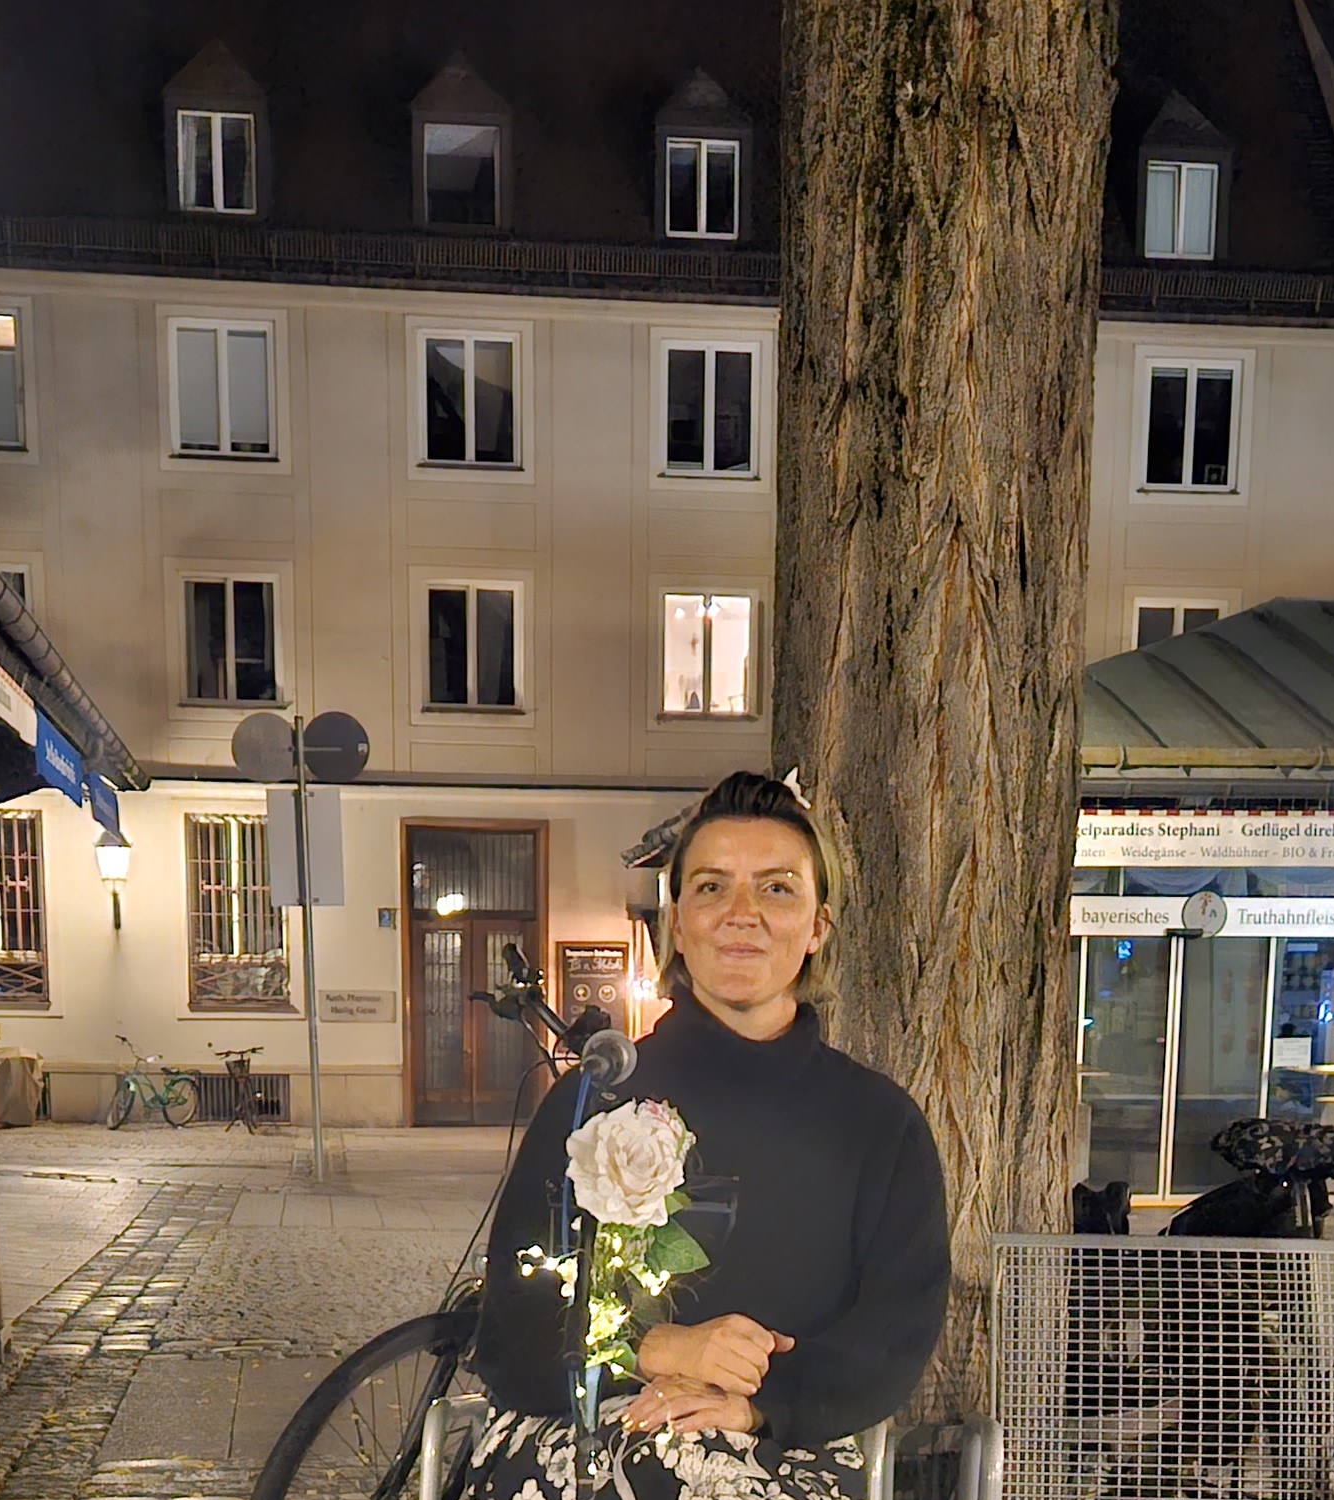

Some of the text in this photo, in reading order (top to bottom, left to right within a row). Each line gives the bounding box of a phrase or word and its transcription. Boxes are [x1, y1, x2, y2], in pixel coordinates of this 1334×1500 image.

[1158, 822, 1220, 840] Stephani
[1241, 822, 1300, 841] Geflügel
[1076, 847, 1106, 858] nten
[1121, 846, 1186, 861] Weidegänse
[1200, 846, 1268, 858] Waldhühner
[1282, 847, 1305, 859] BIO
[1081, 907, 1170, 928] bayerisches
